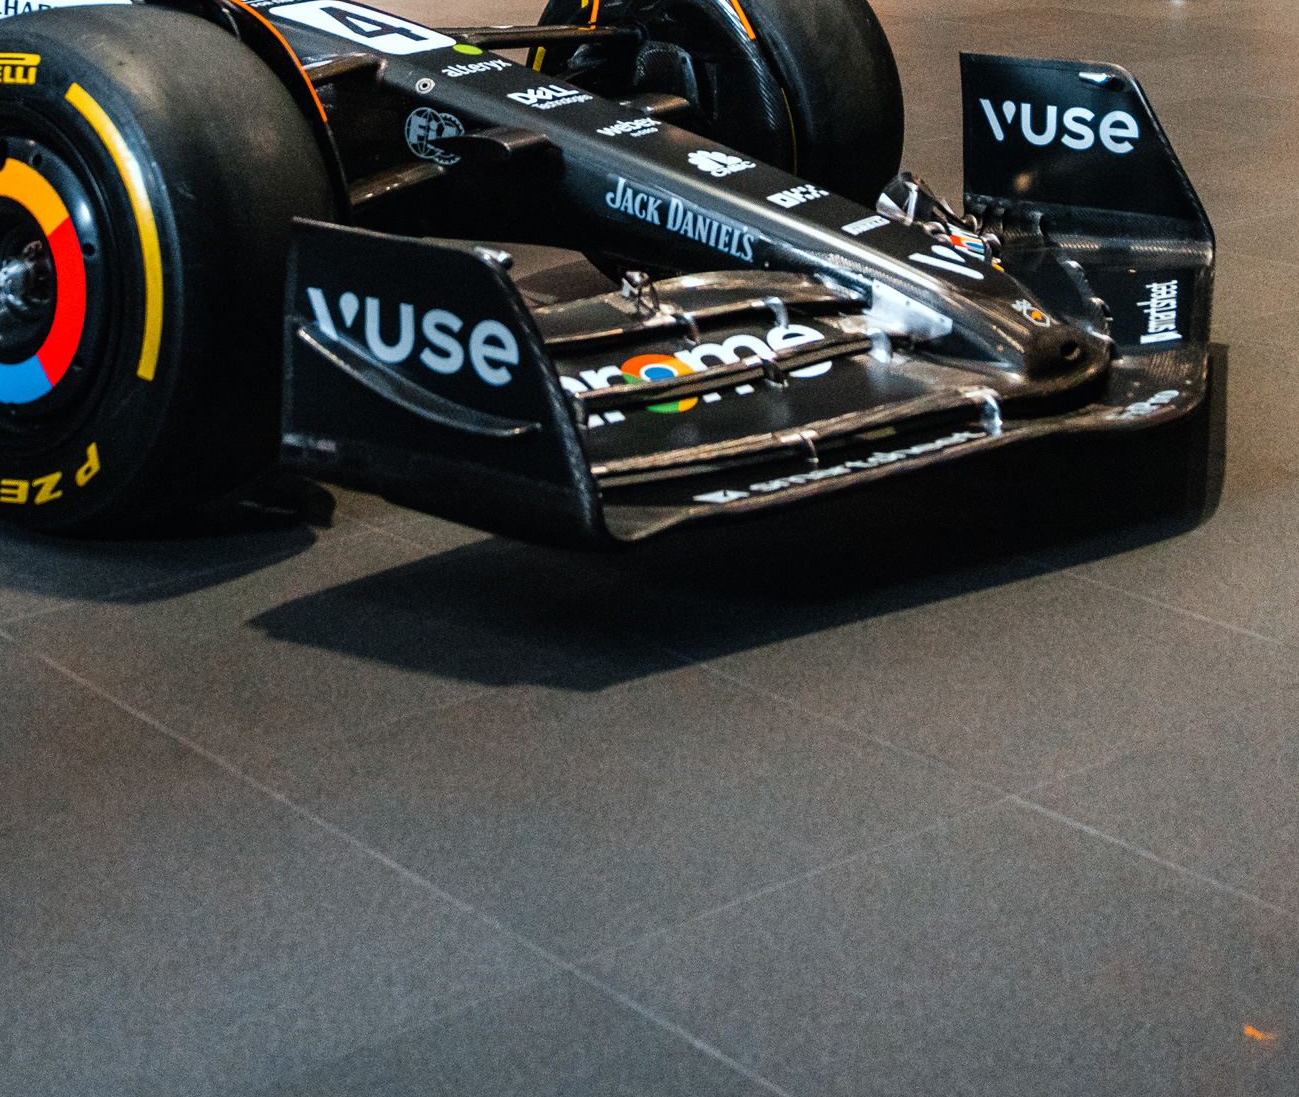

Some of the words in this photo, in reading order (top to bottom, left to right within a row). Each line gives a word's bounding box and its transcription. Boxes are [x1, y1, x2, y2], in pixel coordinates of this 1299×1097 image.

[319, 6, 429, 42] 4
[441, 58, 513, 78] alteryx
[604, 176, 661, 227] JACK
[665, 196, 755, 263] DANIEL'S
[74, 441, 101, 487] P
